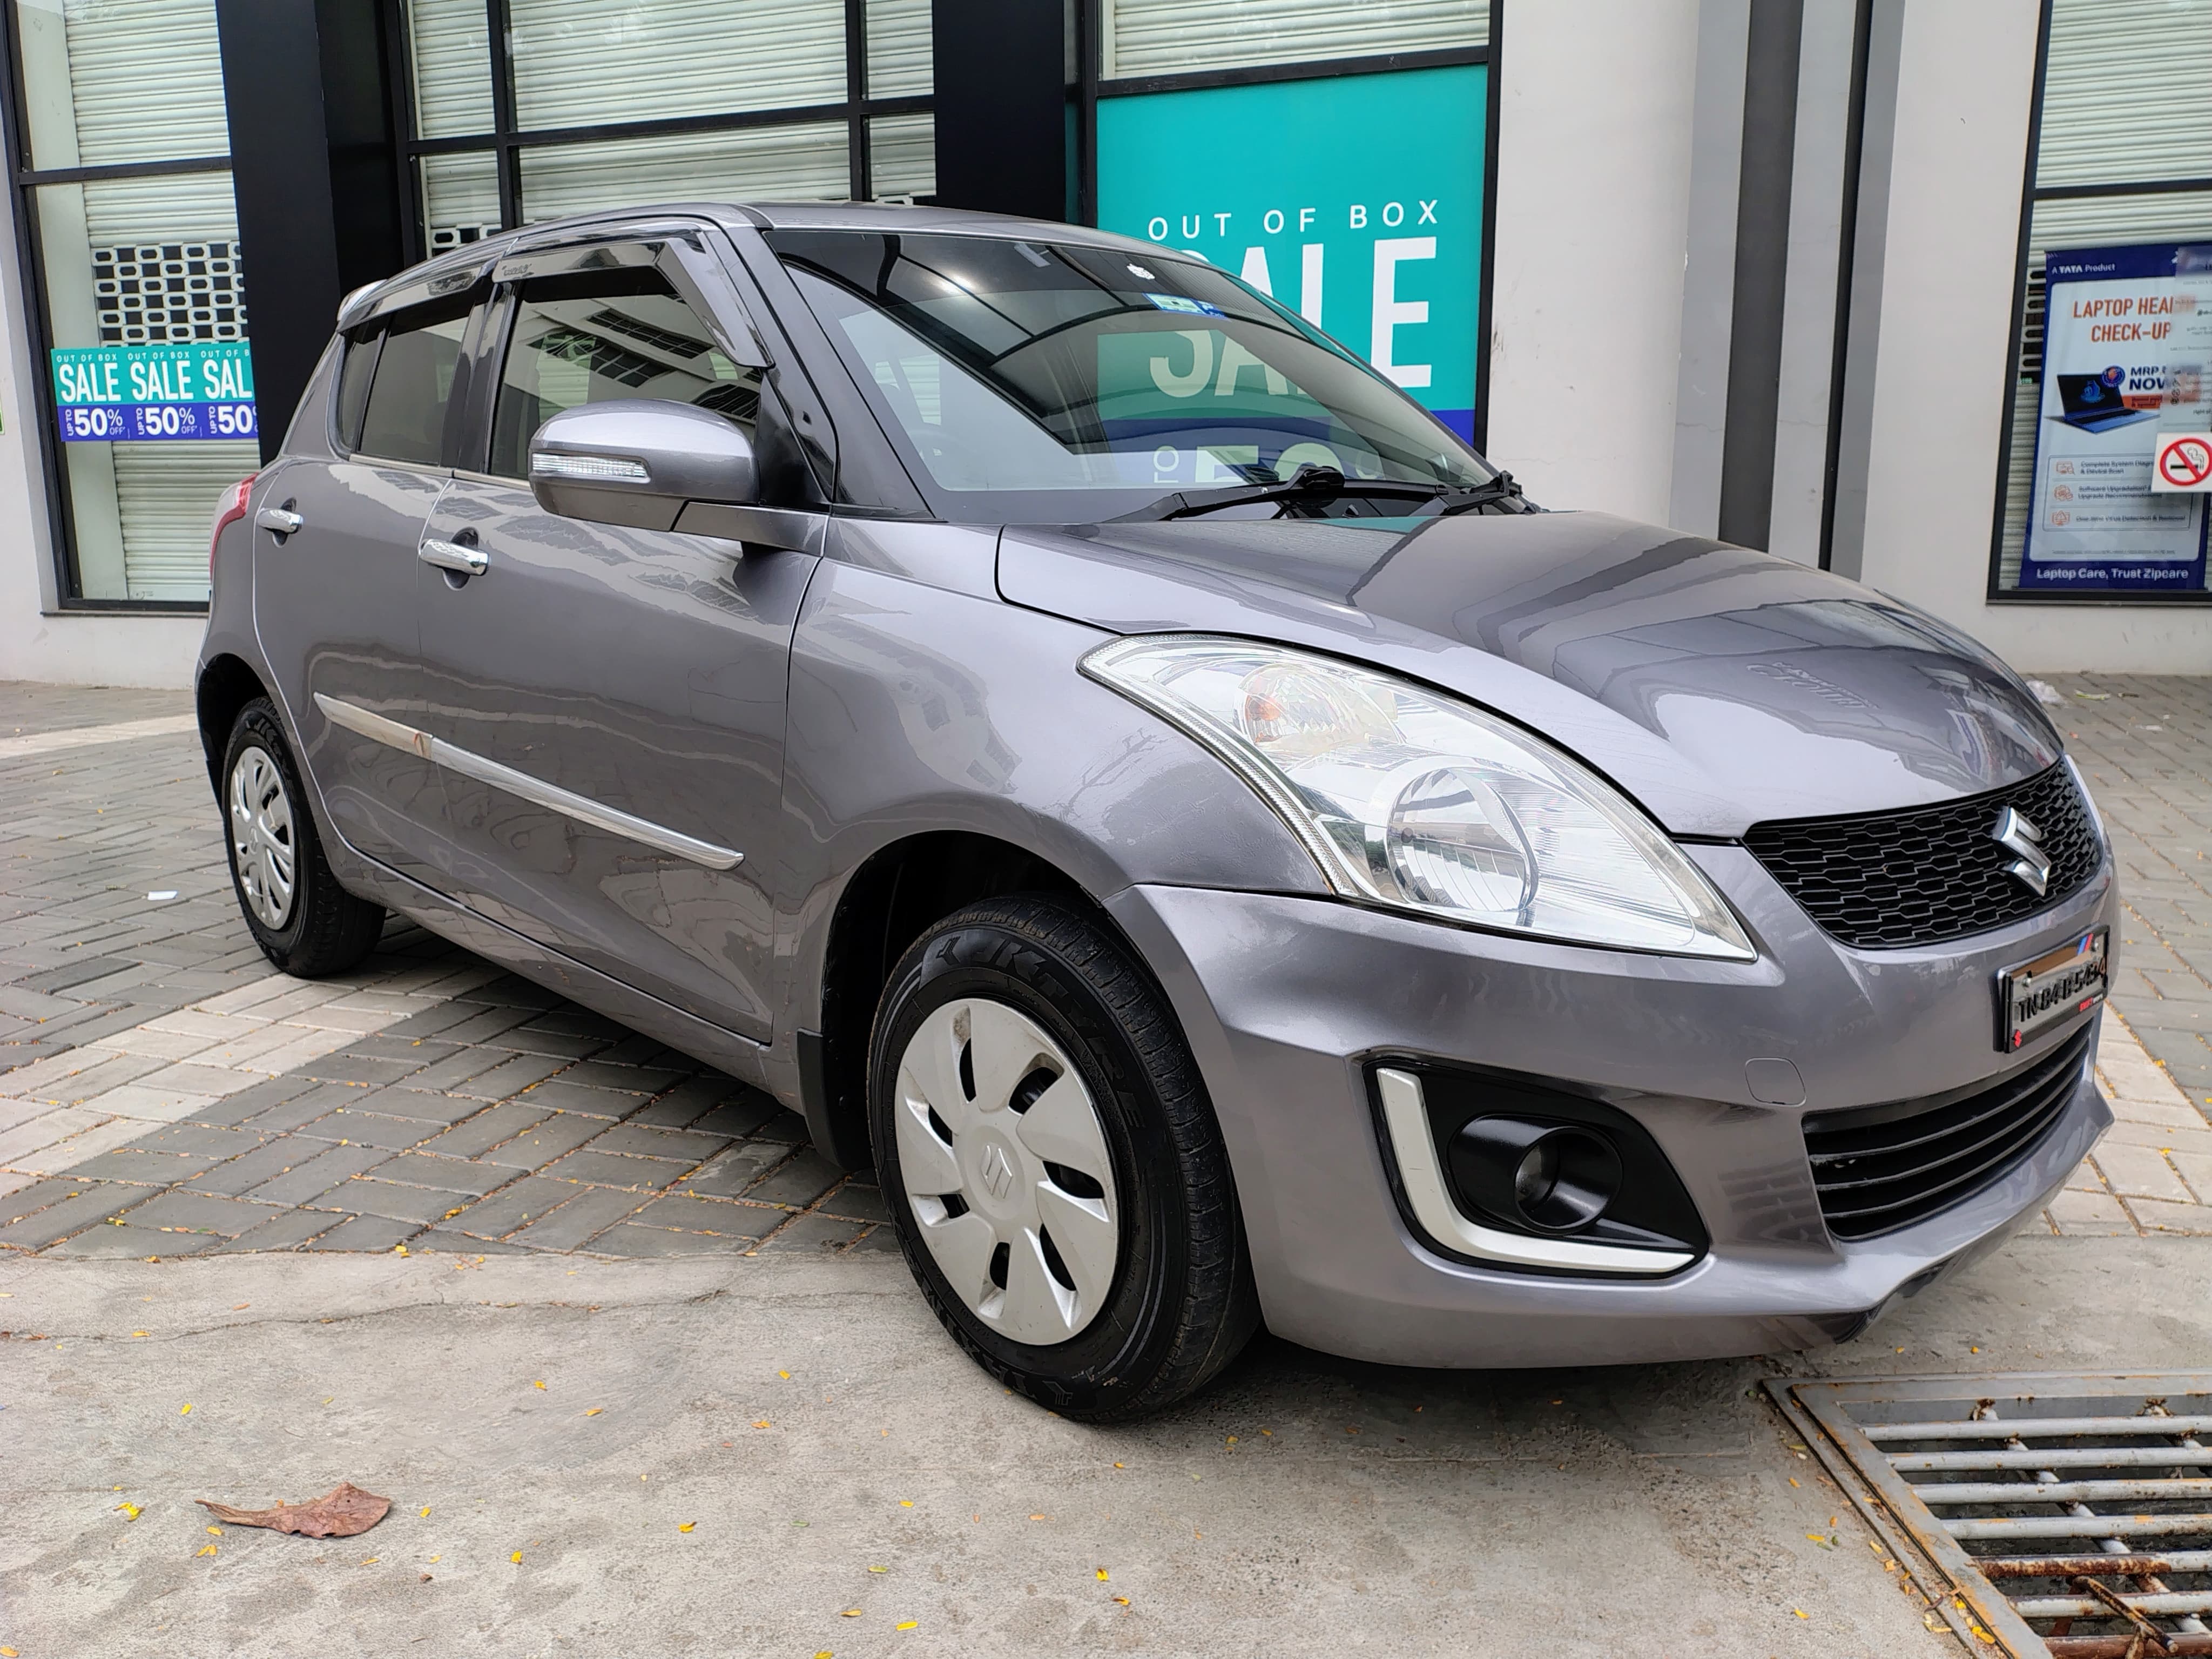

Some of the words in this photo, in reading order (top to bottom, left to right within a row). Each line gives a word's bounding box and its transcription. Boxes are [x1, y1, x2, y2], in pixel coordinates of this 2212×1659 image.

[1148, 212, 1232, 241] OUT
[1263, 207, 1317, 234] OF
[1349, 199, 1439, 230] BOX
[2059, 265, 2083, 274] TATA
[2085, 263, 2115, 272] Product
[2073, 298, 2133, 319] LAPTOP
[2090, 321, 2171, 343] CHECK-UP
[56, 354, 76, 363] OUT
[80, 354, 93, 362] OF
[98, 353, 117, 361] BOX
[127, 352, 147, 361] OUT
[153, 352, 165, 360] OF
[170, 351, 190, 359] BOX
[200, 350, 220, 359] OUT
[226, 349, 238, 358] OF
[130, 360, 194, 401] SALE
[2130, 365, 2159, 376] MRP
[59, 362, 122, 403] SALE
[74, 408, 123, 436] 50%
[145, 406, 195, 435] 50%
[2036, 568, 2076, 581] Laptop
[2078, 568, 2109, 580] Care,
[2110, 568, 2141, 579] Trust
[2143, 567, 2189, 581] Zipcare
